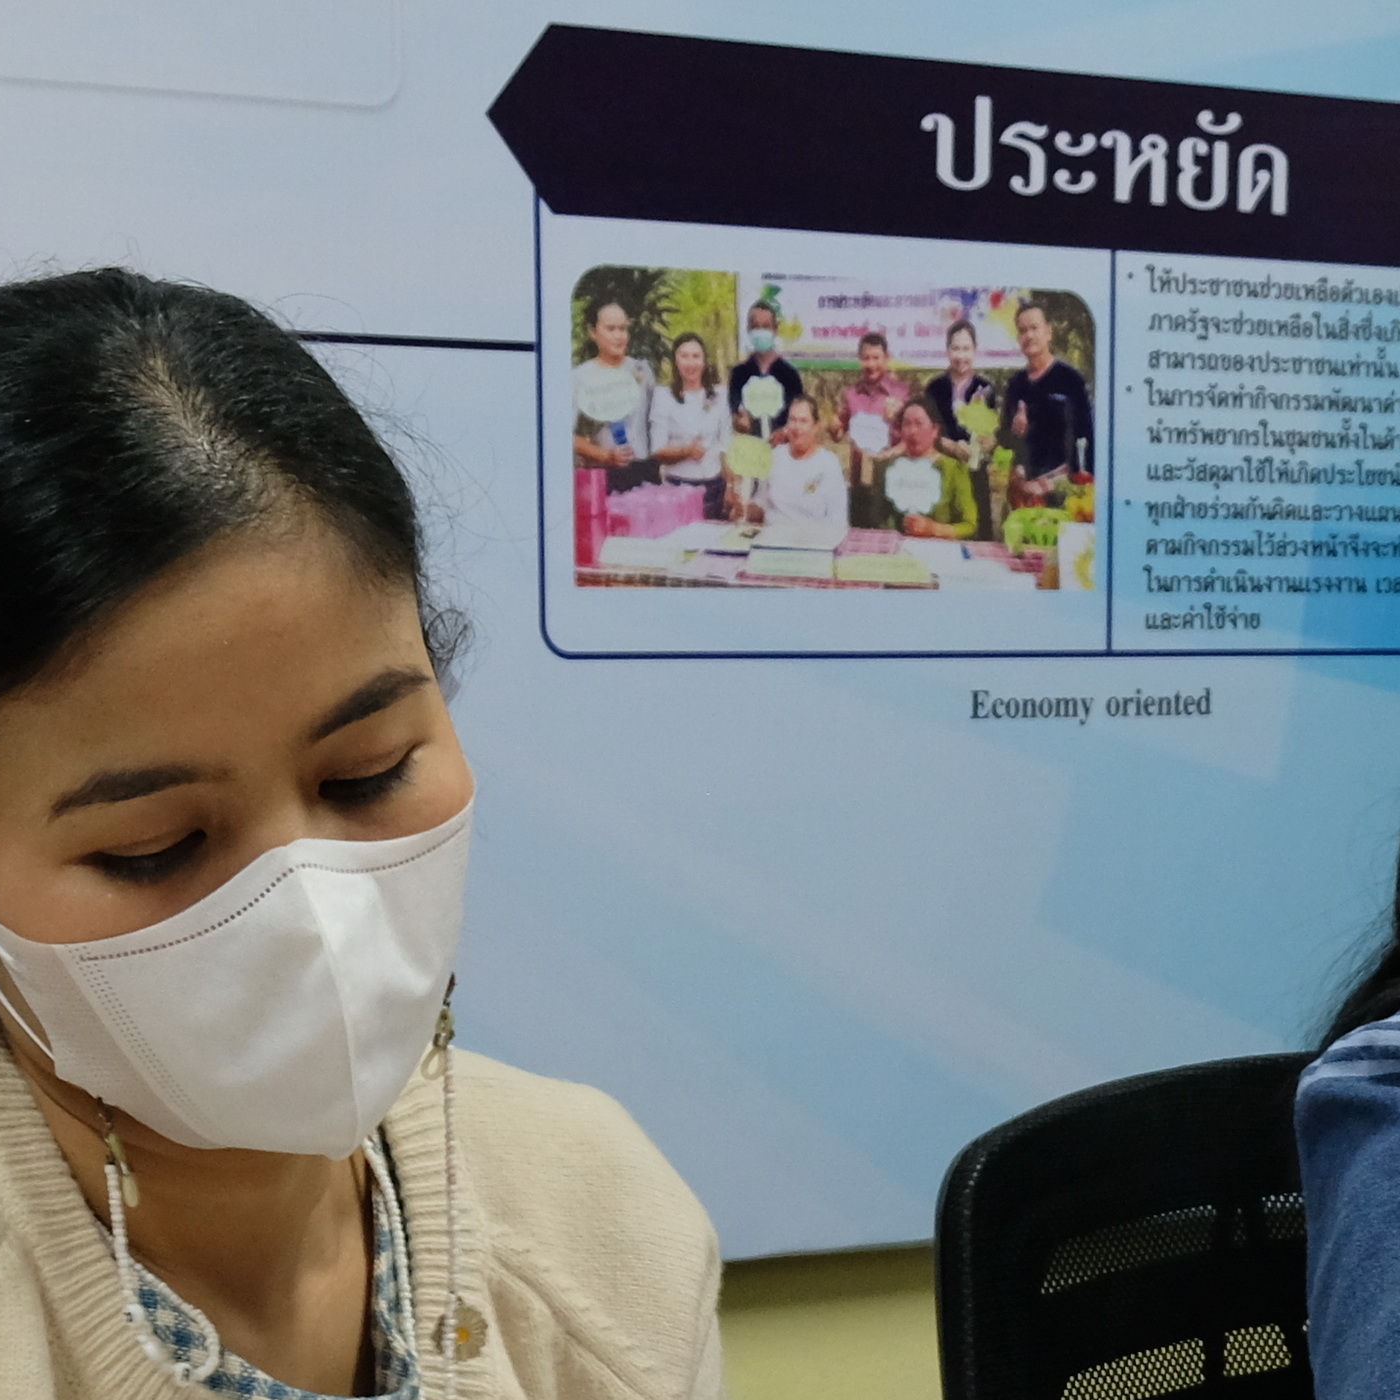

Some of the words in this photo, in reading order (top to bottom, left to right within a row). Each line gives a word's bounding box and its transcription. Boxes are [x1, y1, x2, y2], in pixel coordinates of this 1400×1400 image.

[919, 94, 1290, 216] ประหยัด
[1144, 603, 1262, 632] และค่าใช้จ่าย
[969, 689, 1094, 726] Economy
[1105, 687, 1212, 718] oriented
